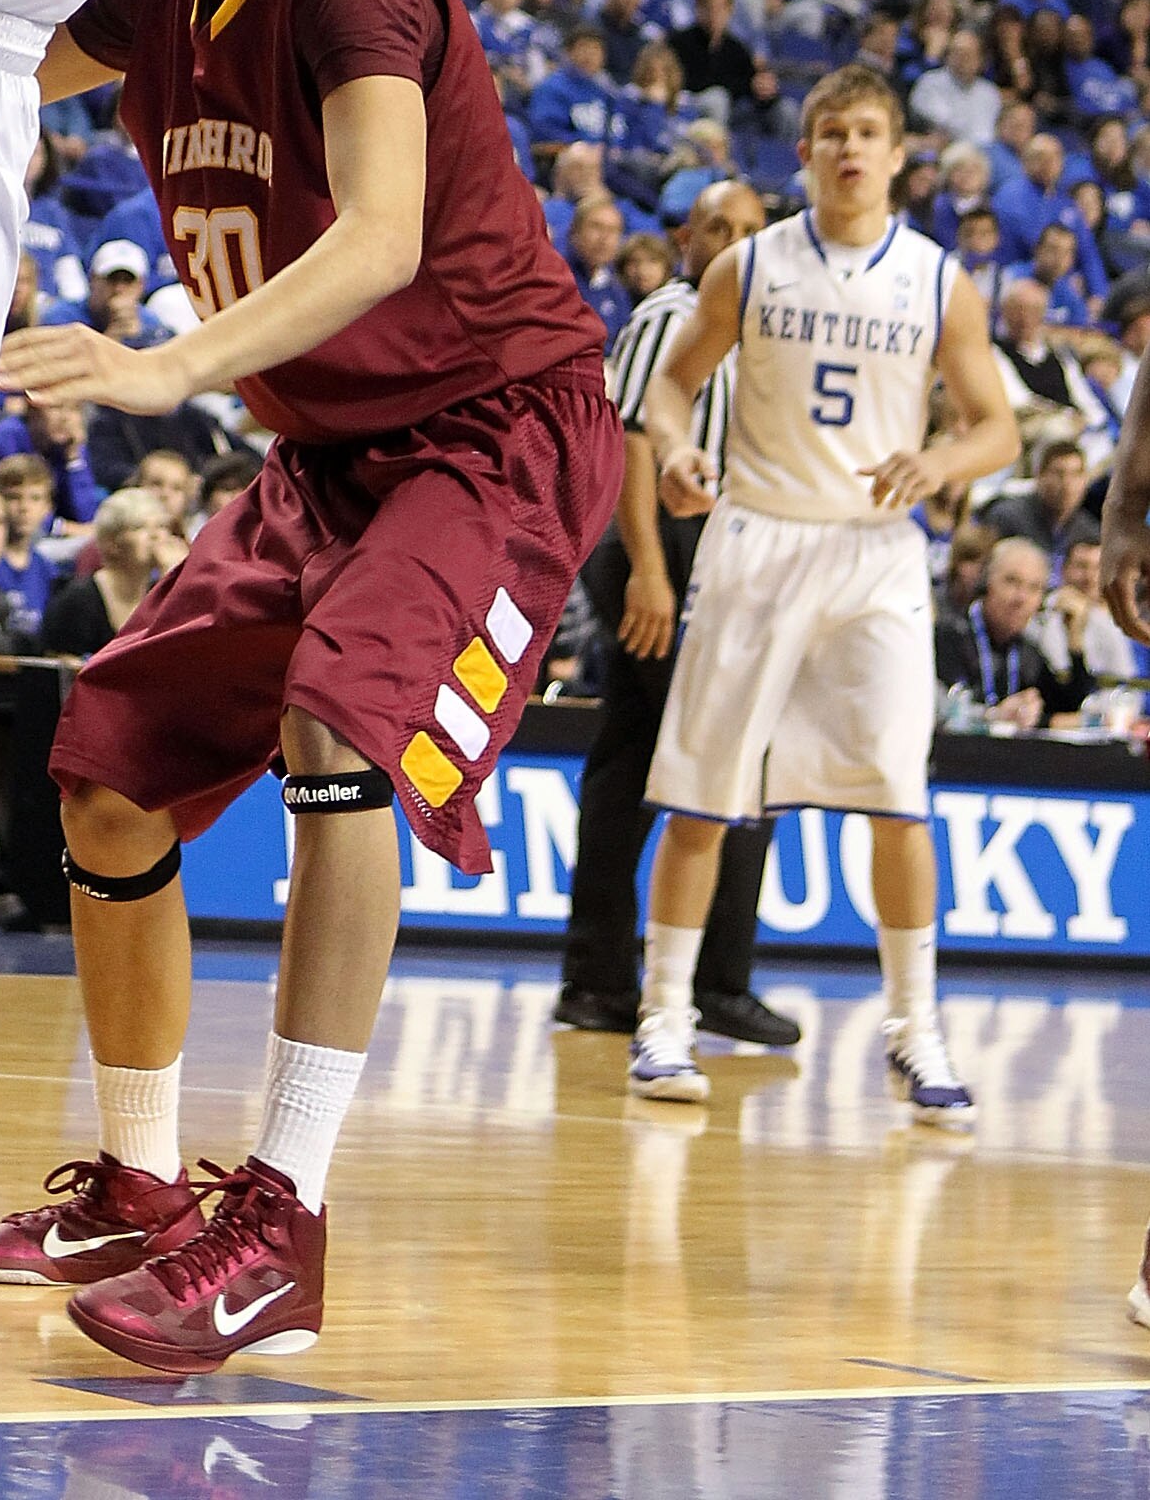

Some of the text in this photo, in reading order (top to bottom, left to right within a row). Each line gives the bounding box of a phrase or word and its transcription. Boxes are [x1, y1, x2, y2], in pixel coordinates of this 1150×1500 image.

[173, 205, 265, 323] 30
[759, 303, 924, 356] KENTUCKY
[810, 360, 859, 427] 5
